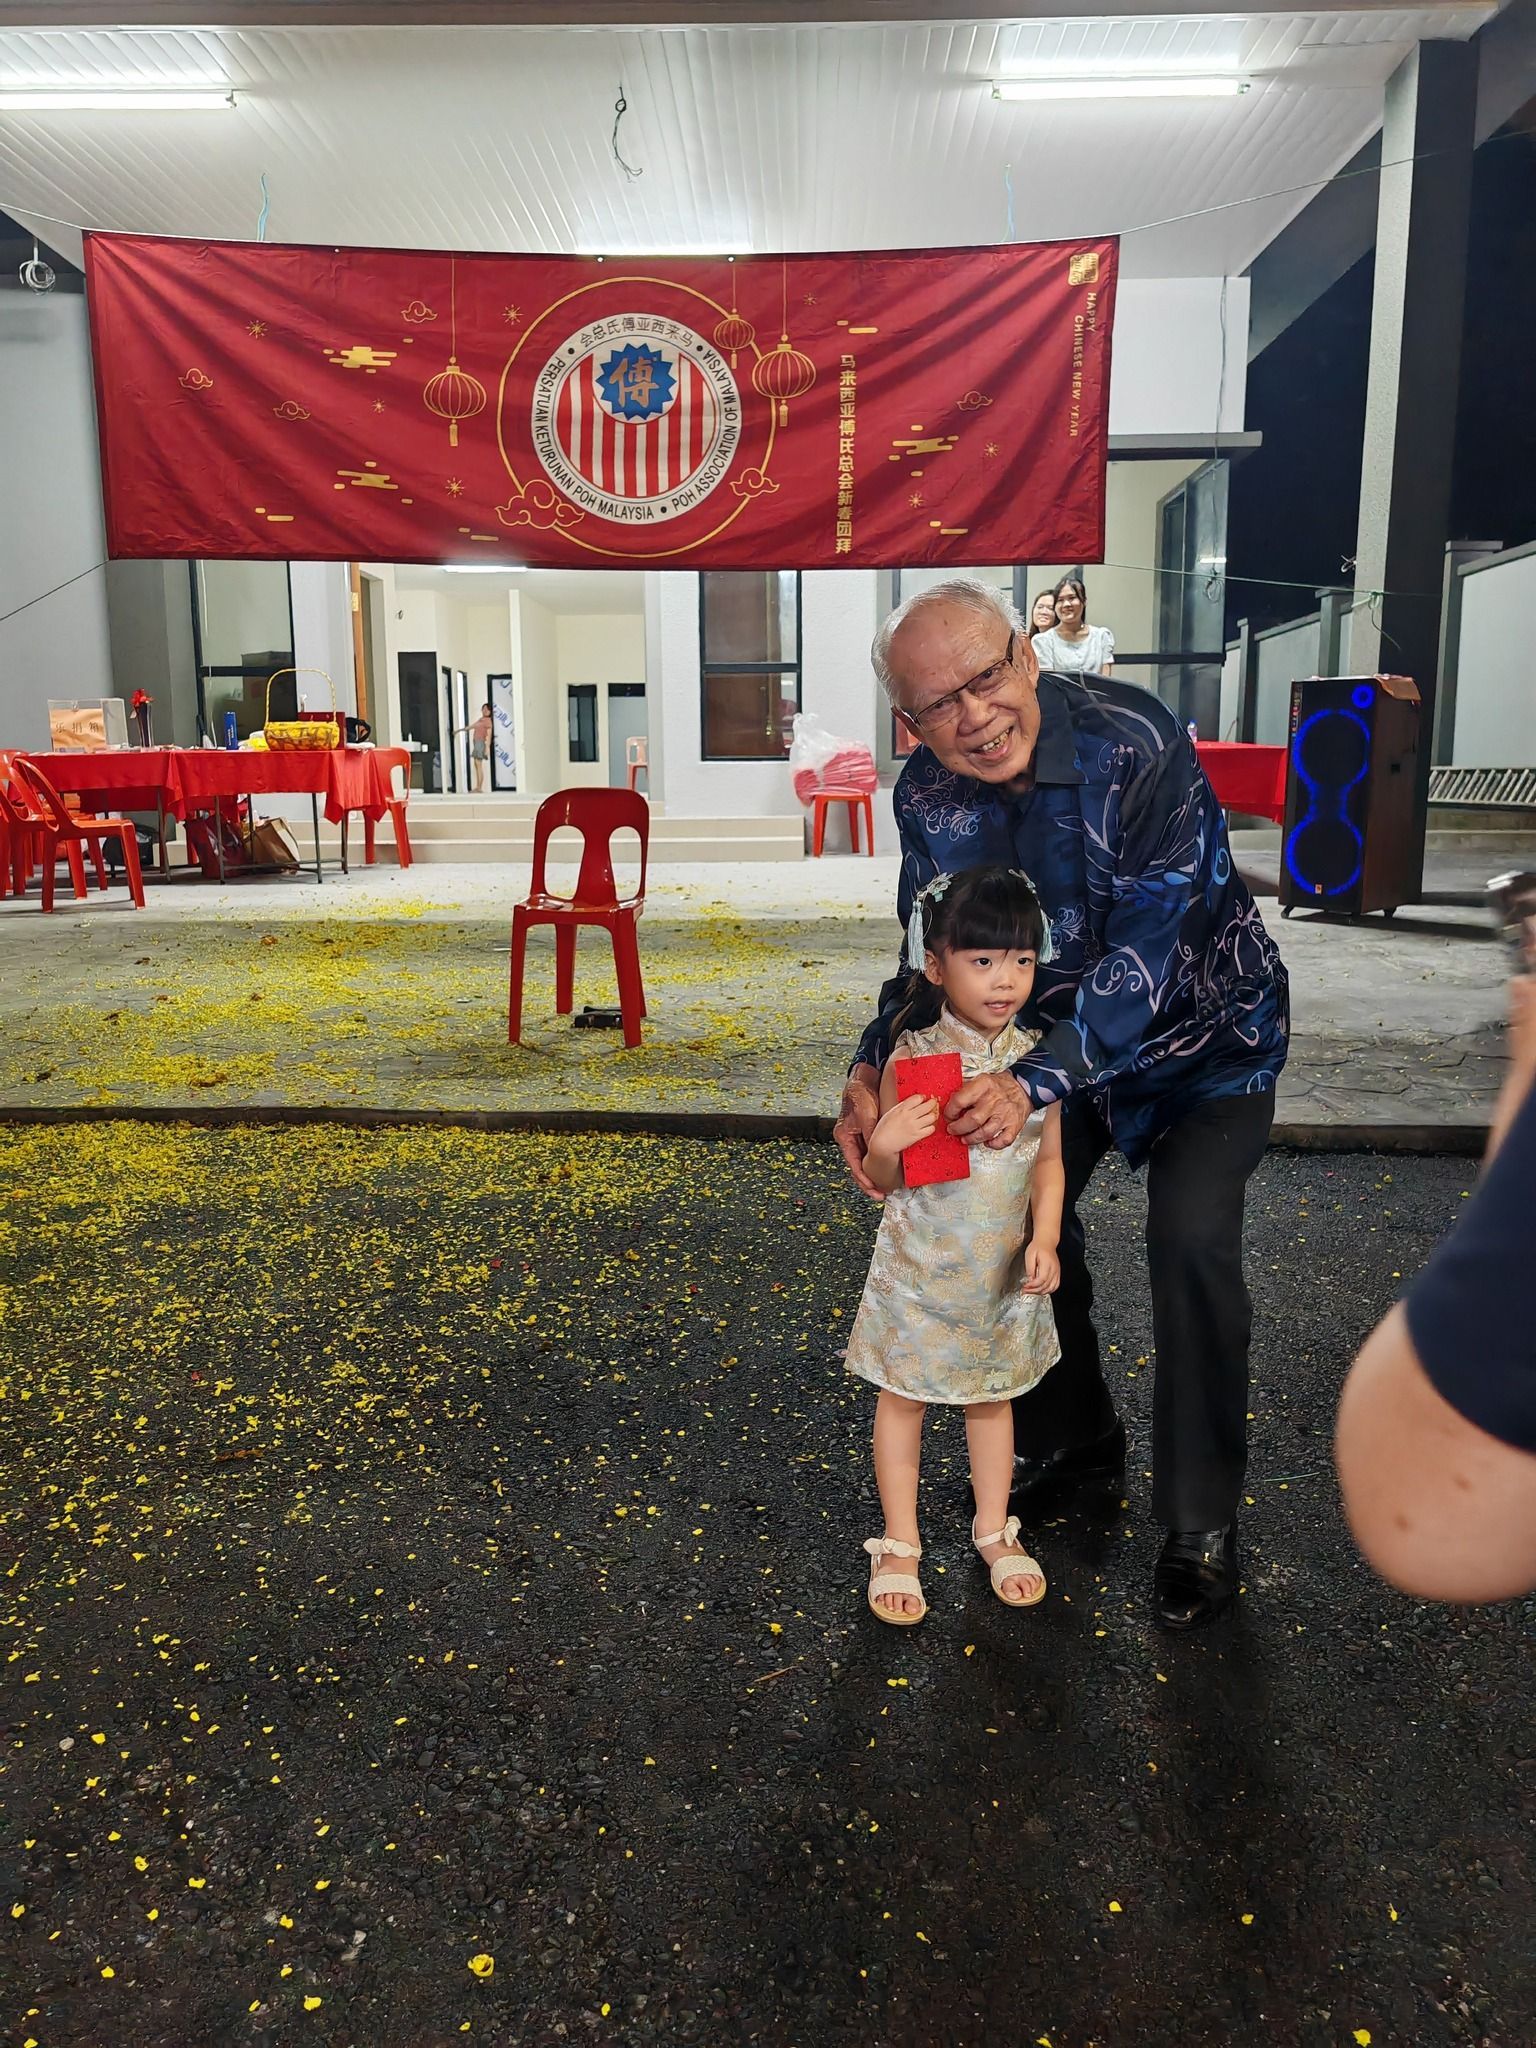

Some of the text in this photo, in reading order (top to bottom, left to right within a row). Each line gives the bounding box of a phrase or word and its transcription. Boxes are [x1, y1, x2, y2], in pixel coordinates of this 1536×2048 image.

[609, 356, 660, 408] 傅
[1069, 315, 1084, 437] CHINESE NEW YEAR
[1086, 292, 1096, 333] HAPPY
[535, 357, 654, 520] PERSATUAN KETURUNAN POH MALAYSIA
[671, 350, 738, 512] POH ASSOCIATION OF MALAYSIA
[835, 354, 857, 554] 马来西亚傅氏总会新春团拜
